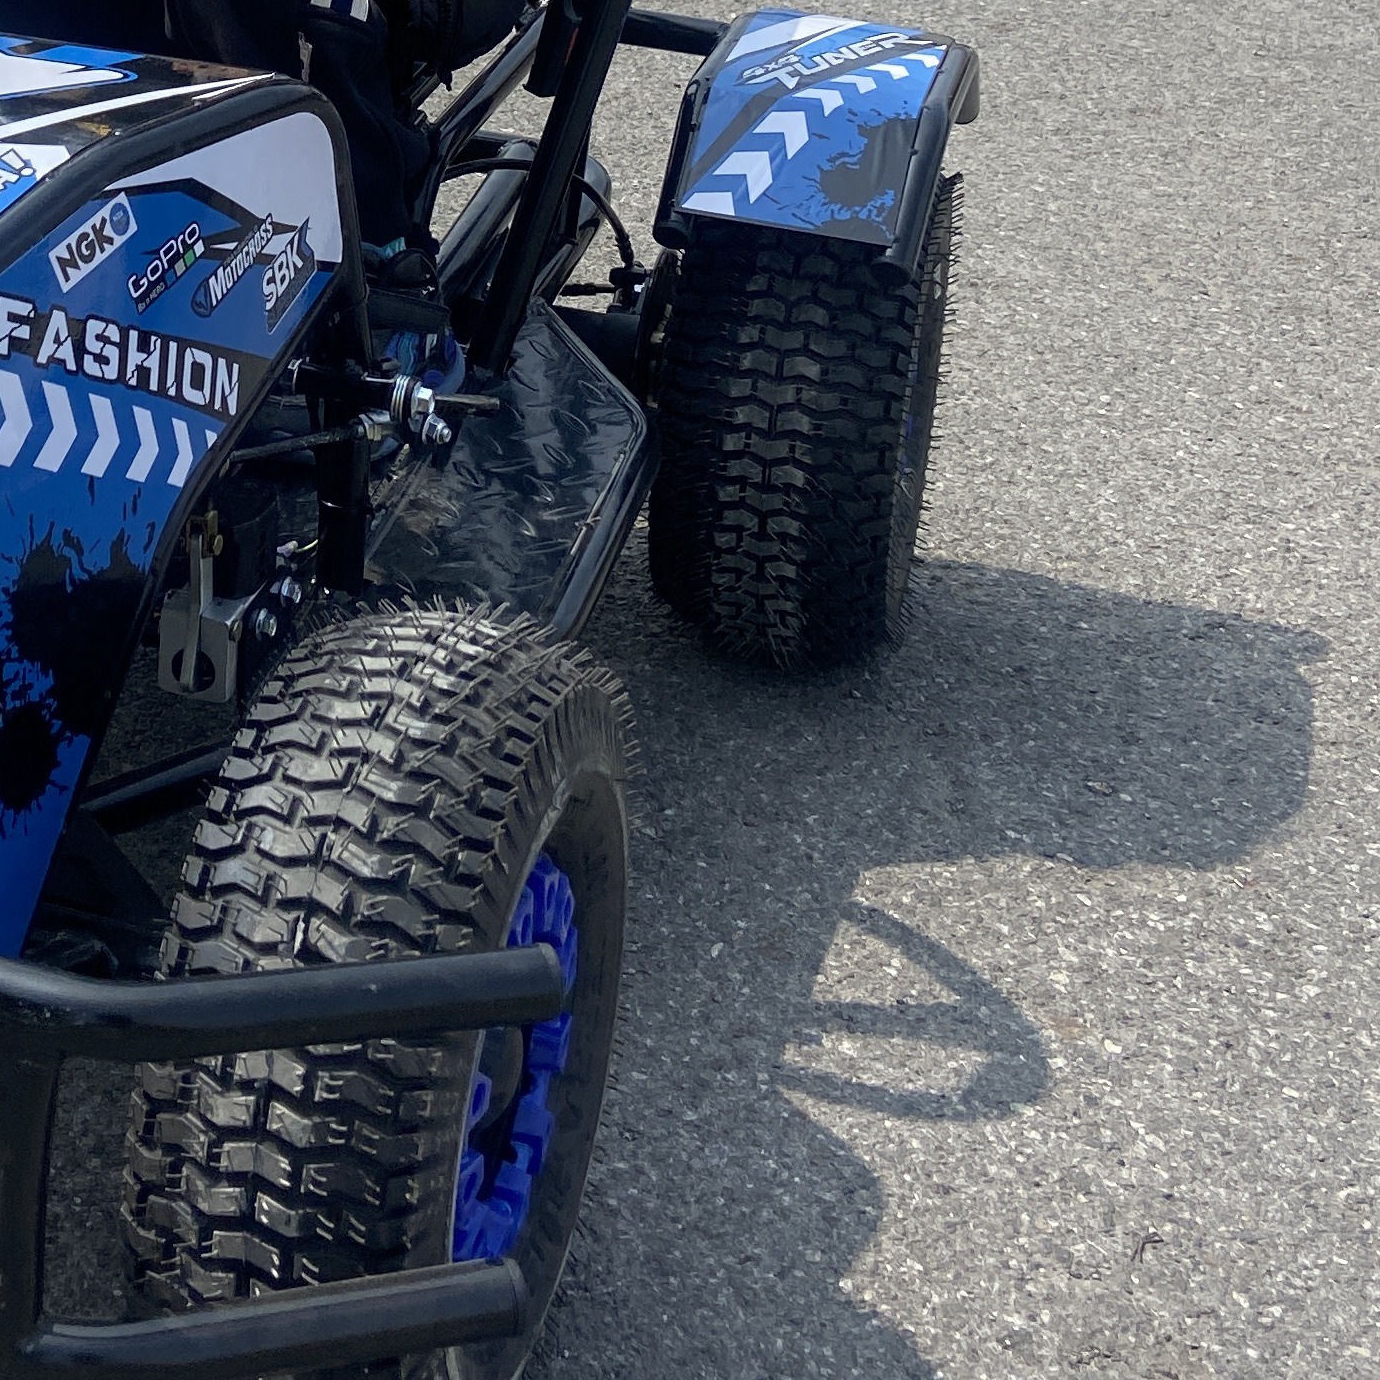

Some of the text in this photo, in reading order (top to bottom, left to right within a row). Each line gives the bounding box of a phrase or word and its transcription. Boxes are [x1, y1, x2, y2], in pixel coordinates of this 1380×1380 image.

[745, 32, 934, 90] TUNER
[55, 215, 115, 284] NGK
[128, 222, 200, 299] GoPro
[262, 231, 304, 311] SBK
